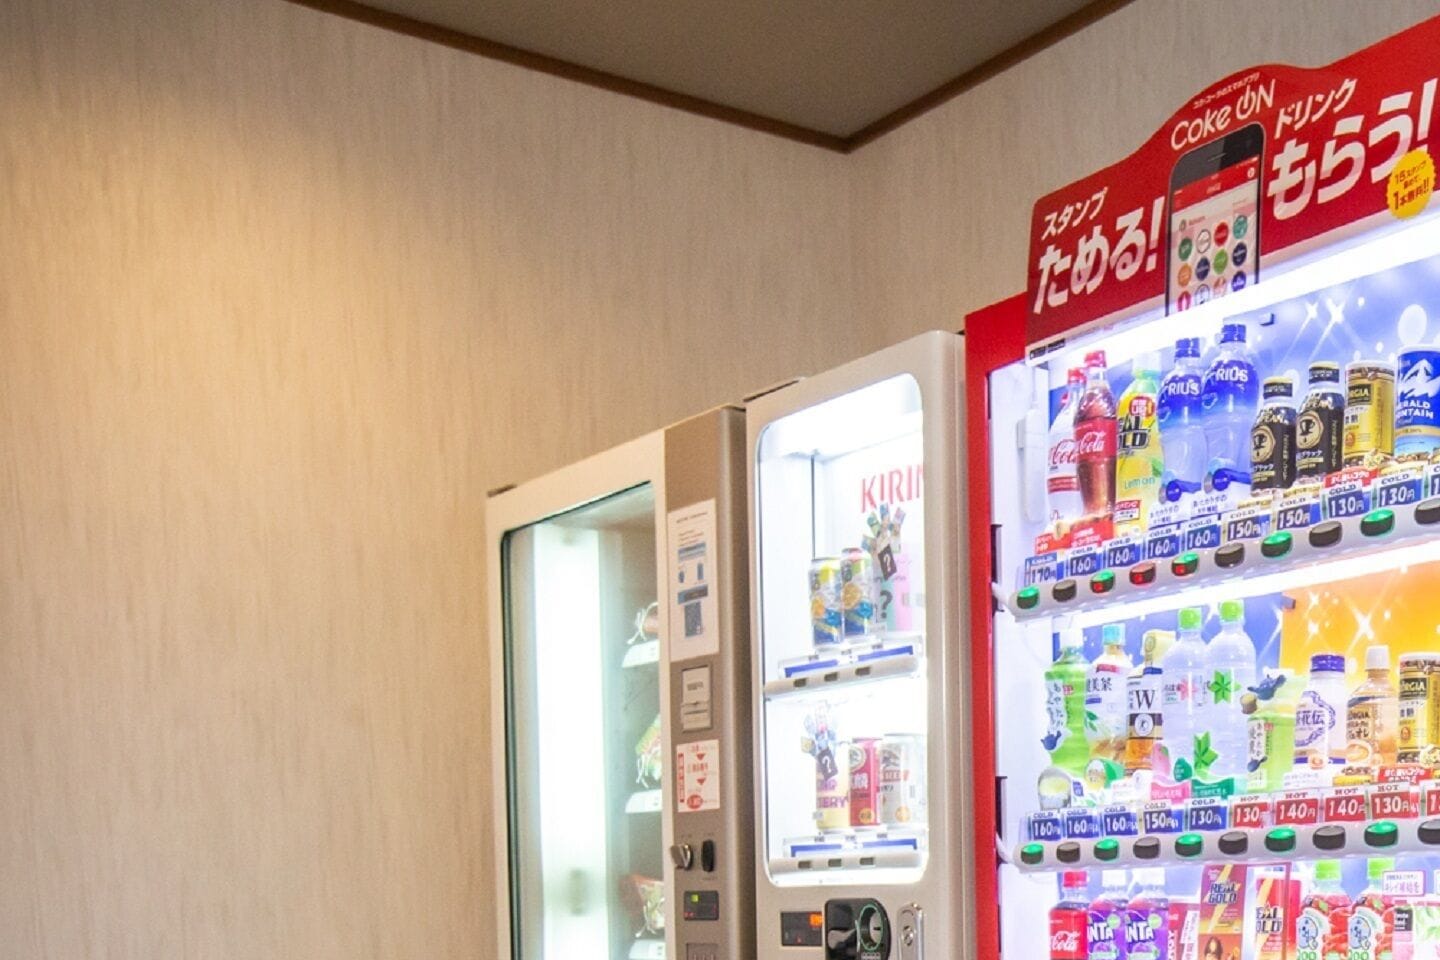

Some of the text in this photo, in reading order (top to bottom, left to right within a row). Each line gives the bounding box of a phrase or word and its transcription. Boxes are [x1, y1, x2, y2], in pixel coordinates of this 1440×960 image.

[1171, 78, 1276, 150] Coke ON
[1273, 78, 1358, 138] ドリンク
[1042, 188, 1109, 241] スタンプ
[1033, 196, 1164, 315] ためる!
[1381, 473, 1410, 485] COLD
[1329, 485, 1356, 496] COLD
[1380, 486, 1415, 507] 130円
[1329, 496, 1364, 517] 130円
[1377, 784, 1400, 792] HOT
[1280, 803, 1315, 820] 140円
[1375, 797, 1410, 814] 130円
